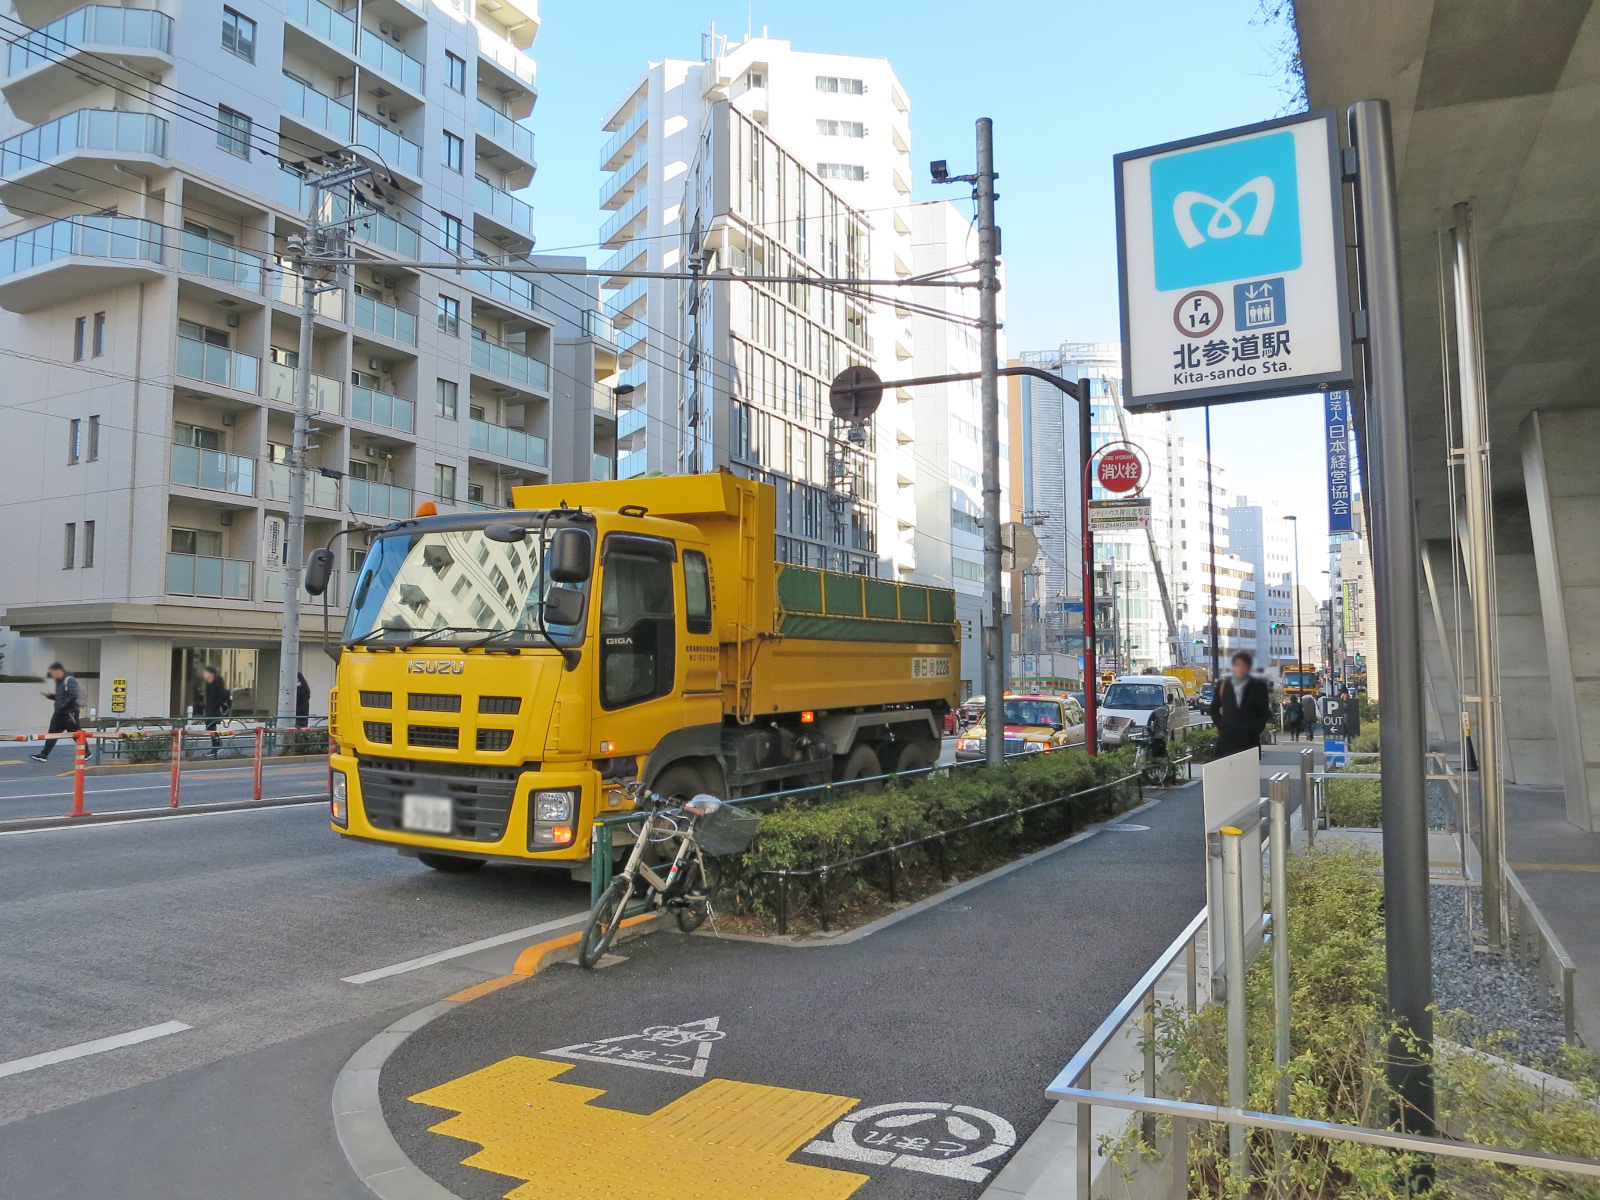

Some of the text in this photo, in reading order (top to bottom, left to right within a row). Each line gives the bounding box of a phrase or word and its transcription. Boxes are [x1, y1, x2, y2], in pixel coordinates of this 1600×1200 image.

[1194, 299, 1202, 311] F
[1189, 312, 1211, 328] 14
[1173, 329, 1291, 370] 北参道駅
[1173, 361, 1292, 385] Kita-sando Sta.
[1101, 462, 1139, 480] 消火栓
[606, 637, 634, 645] GIGA
[408, 660, 465, 675] ISUZU
[1327, 701, 1339, 715] P
[1323, 716, 1343, 726] OUT
[588, 1044, 692, 1066] とまれ
[863, 1131, 967, 1156] とまれ
